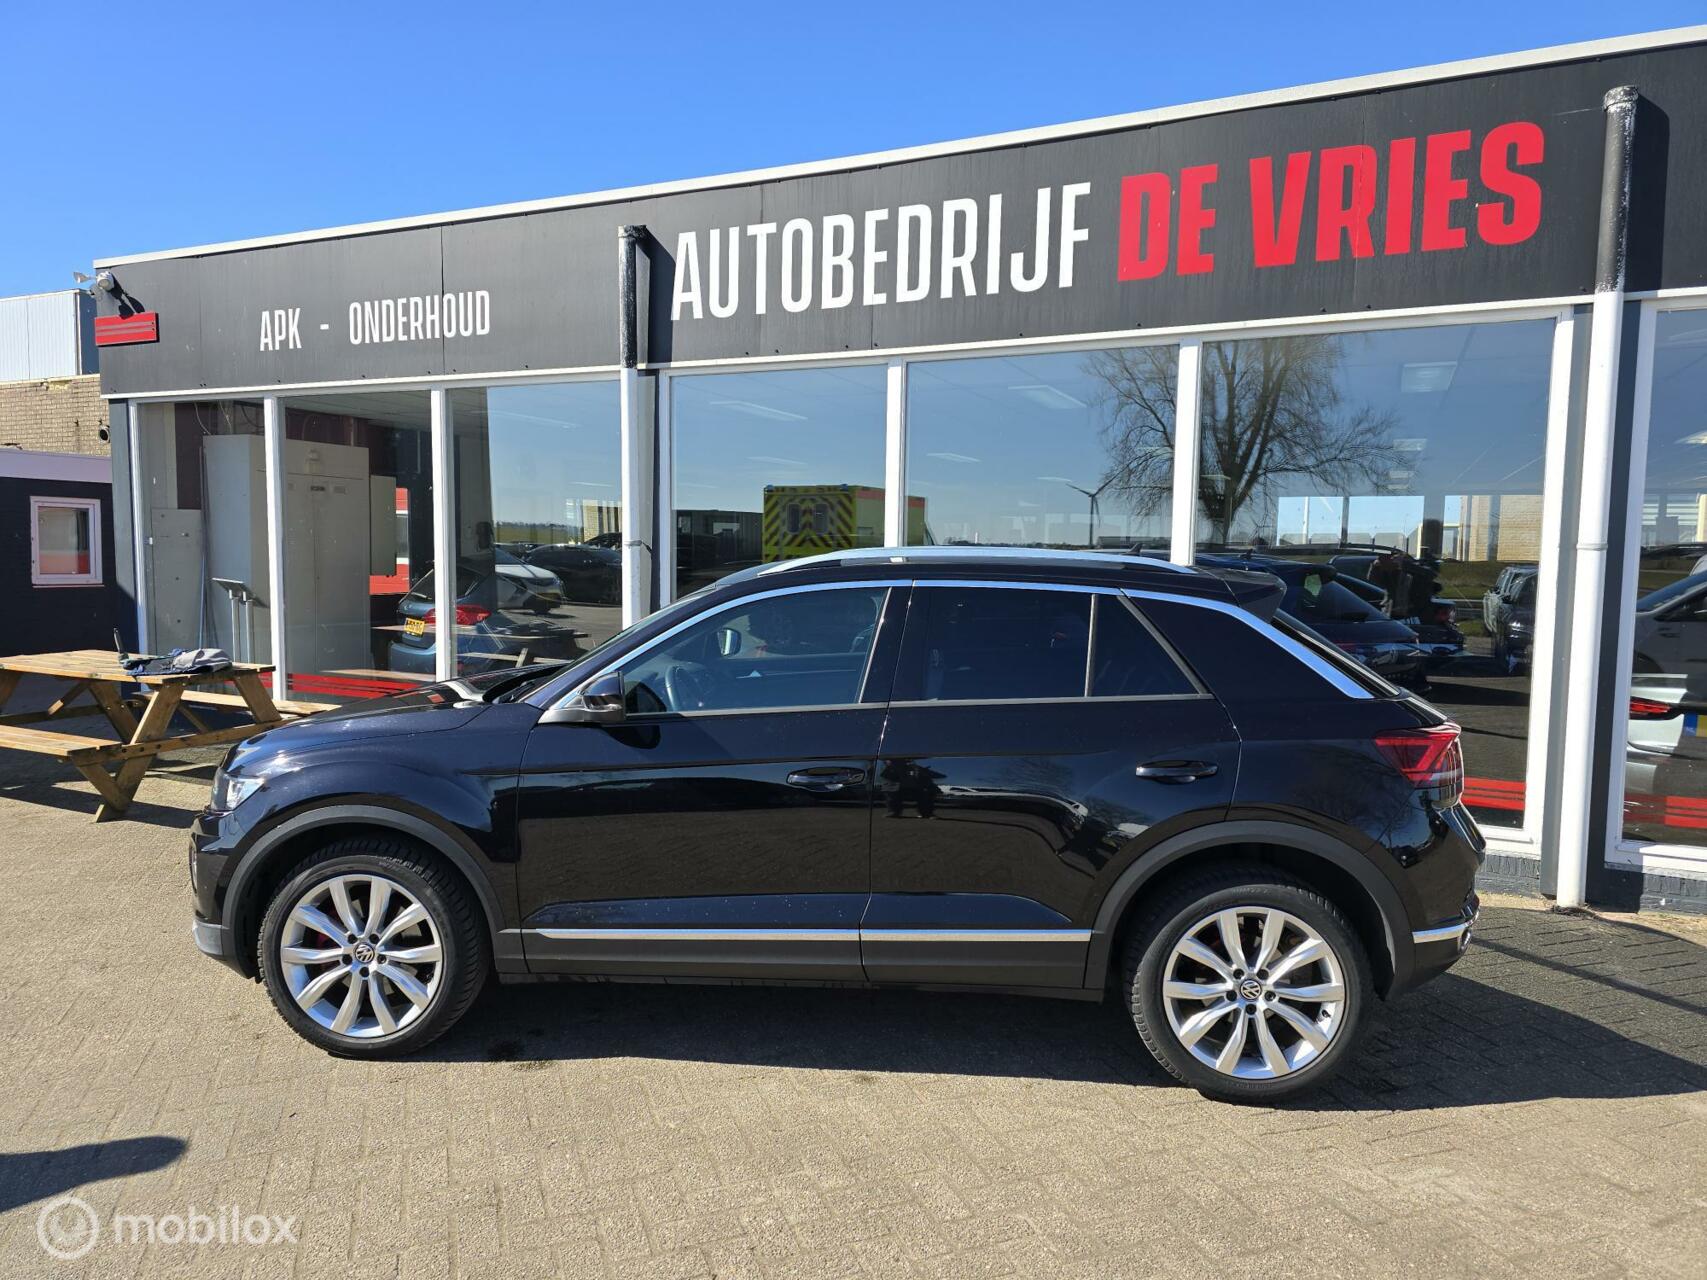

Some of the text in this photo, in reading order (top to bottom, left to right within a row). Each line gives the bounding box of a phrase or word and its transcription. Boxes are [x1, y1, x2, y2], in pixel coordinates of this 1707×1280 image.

[670, 121, 1545, 321] AUTOBEDRIJF DE VRIES
[259, 307, 302, 352] APK
[349, 290, 491, 345] ONDERHOUD
